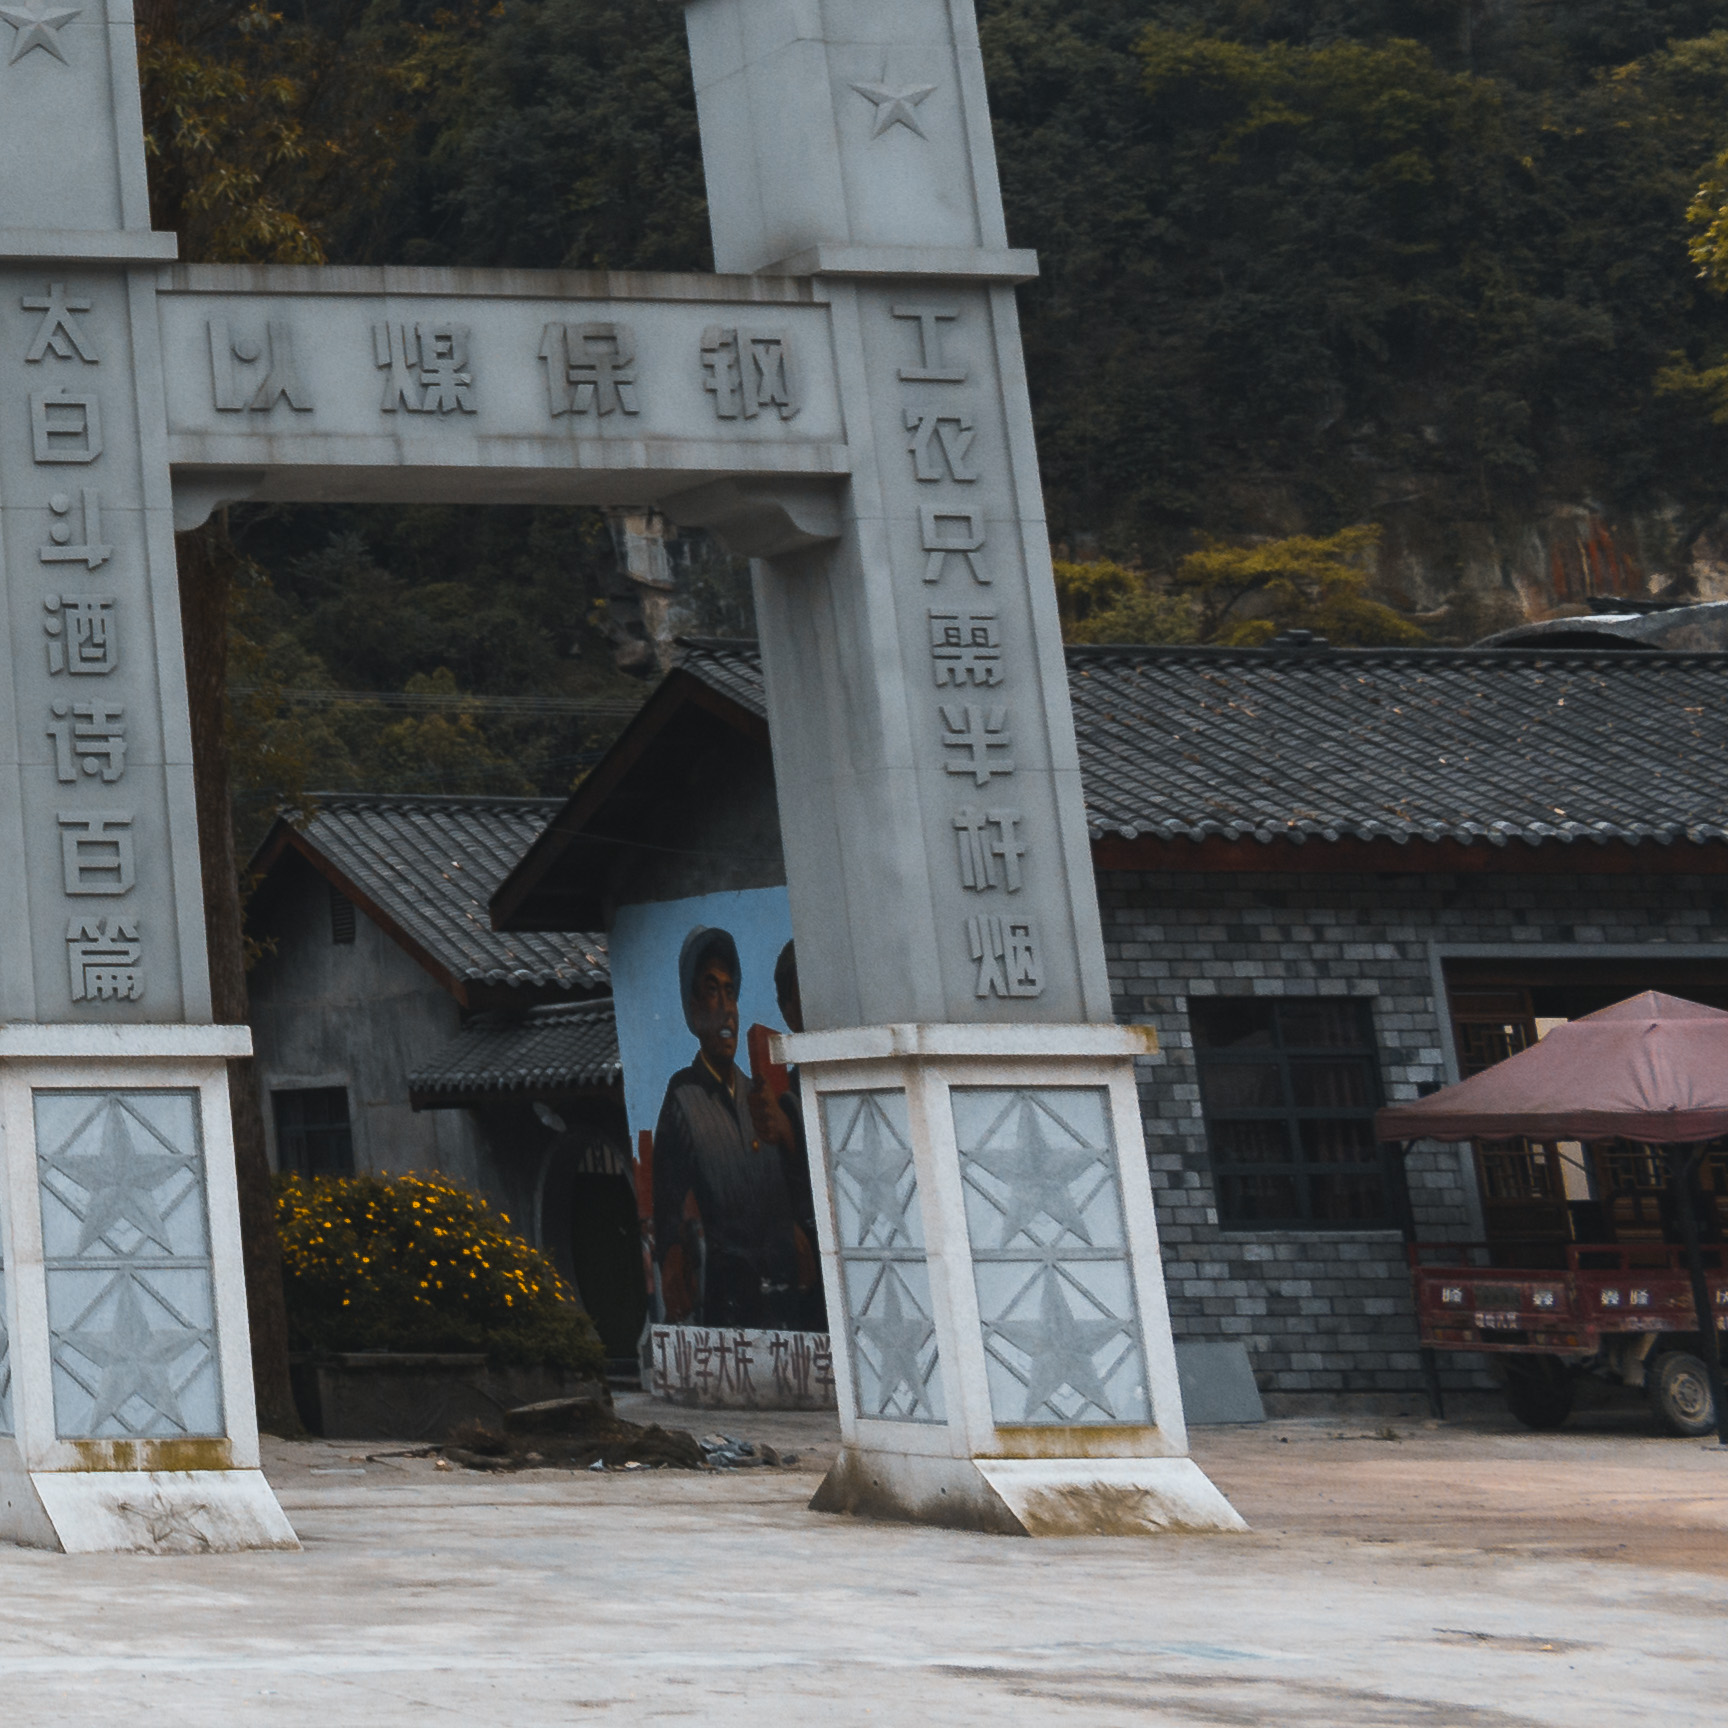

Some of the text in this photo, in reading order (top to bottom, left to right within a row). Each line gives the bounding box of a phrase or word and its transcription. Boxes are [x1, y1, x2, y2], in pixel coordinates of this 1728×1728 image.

[206, 320, 802, 421] 以煤保钢
[21, 282, 144, 1006] 太白斗酒诗百篇
[891, 305, 1046, 1000] 工农只需半杆烟
[653, 1330, 757, 1394] 工业学大庆
